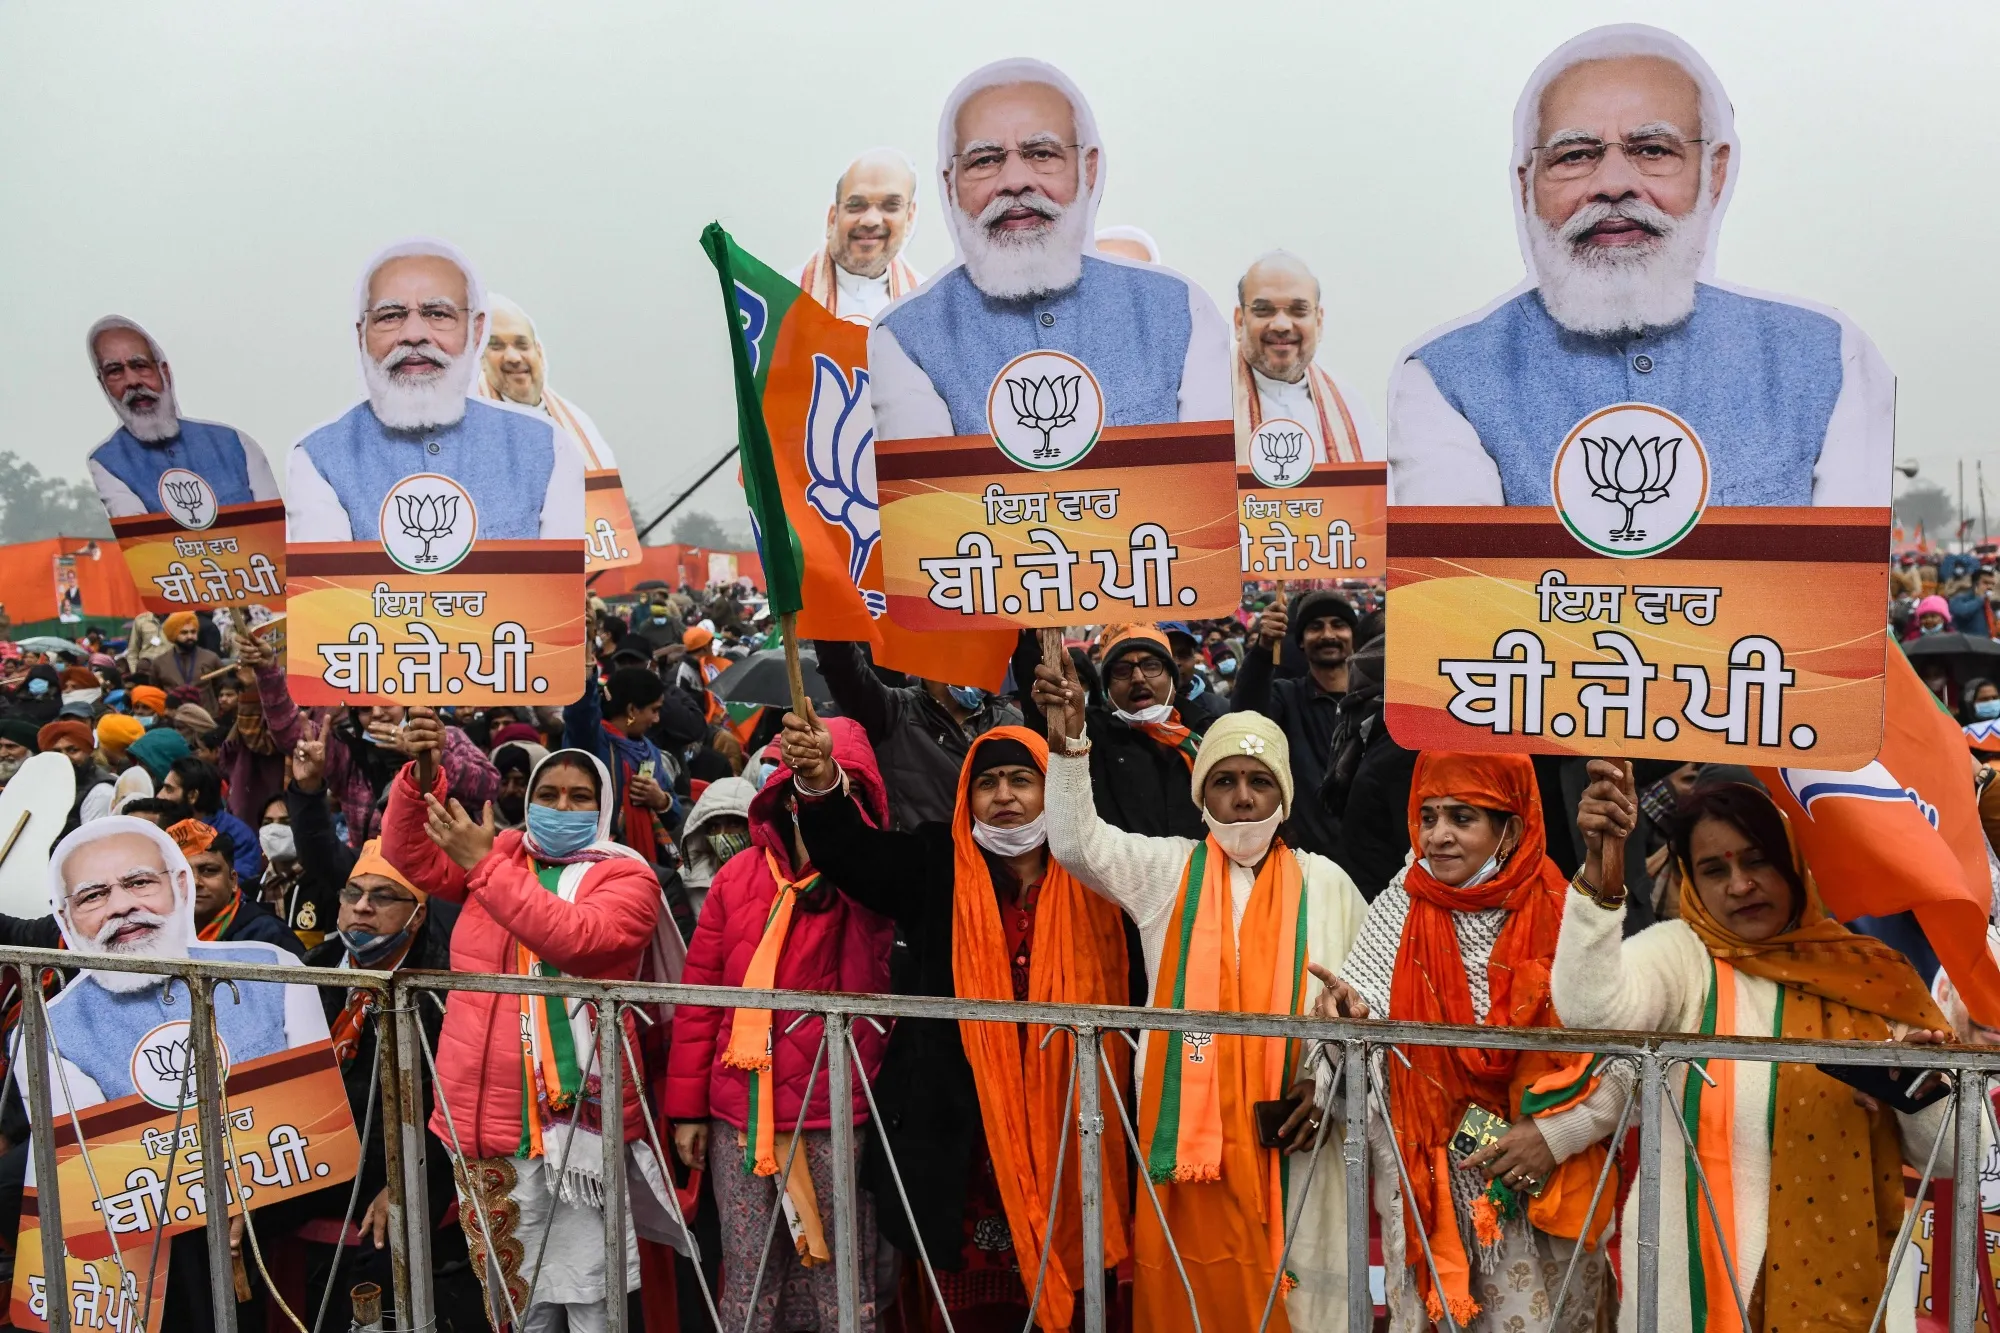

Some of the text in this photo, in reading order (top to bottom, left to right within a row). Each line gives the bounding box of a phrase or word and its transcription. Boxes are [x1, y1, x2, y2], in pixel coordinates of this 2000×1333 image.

[982, 484, 1120, 525] ਇਸ ਵਾਰ
[1243, 494, 1324, 519] ਇਸ ਵਾਰ
[173, 536, 239, 558] ਇਸ ਵਾਰ
[919, 523, 1198, 615] ਬੀ.ਜੇ.ਪੀ.
[152, 553, 286, 604] ਬੀ.ਜੇ.ਪੀ
[372, 582, 487, 618] ਇਸ ਵਾਰ
[1536, 569, 1722, 626] ਇਸ ਵਾਰ
[317, 621, 549, 694] ਬੀ.ਜੇ.ਪੀ.
[1439, 628, 1818, 751] ਬੀ.ਜੇ.ਪੀ.
[140, 1123, 199, 1160] ਇਸ
